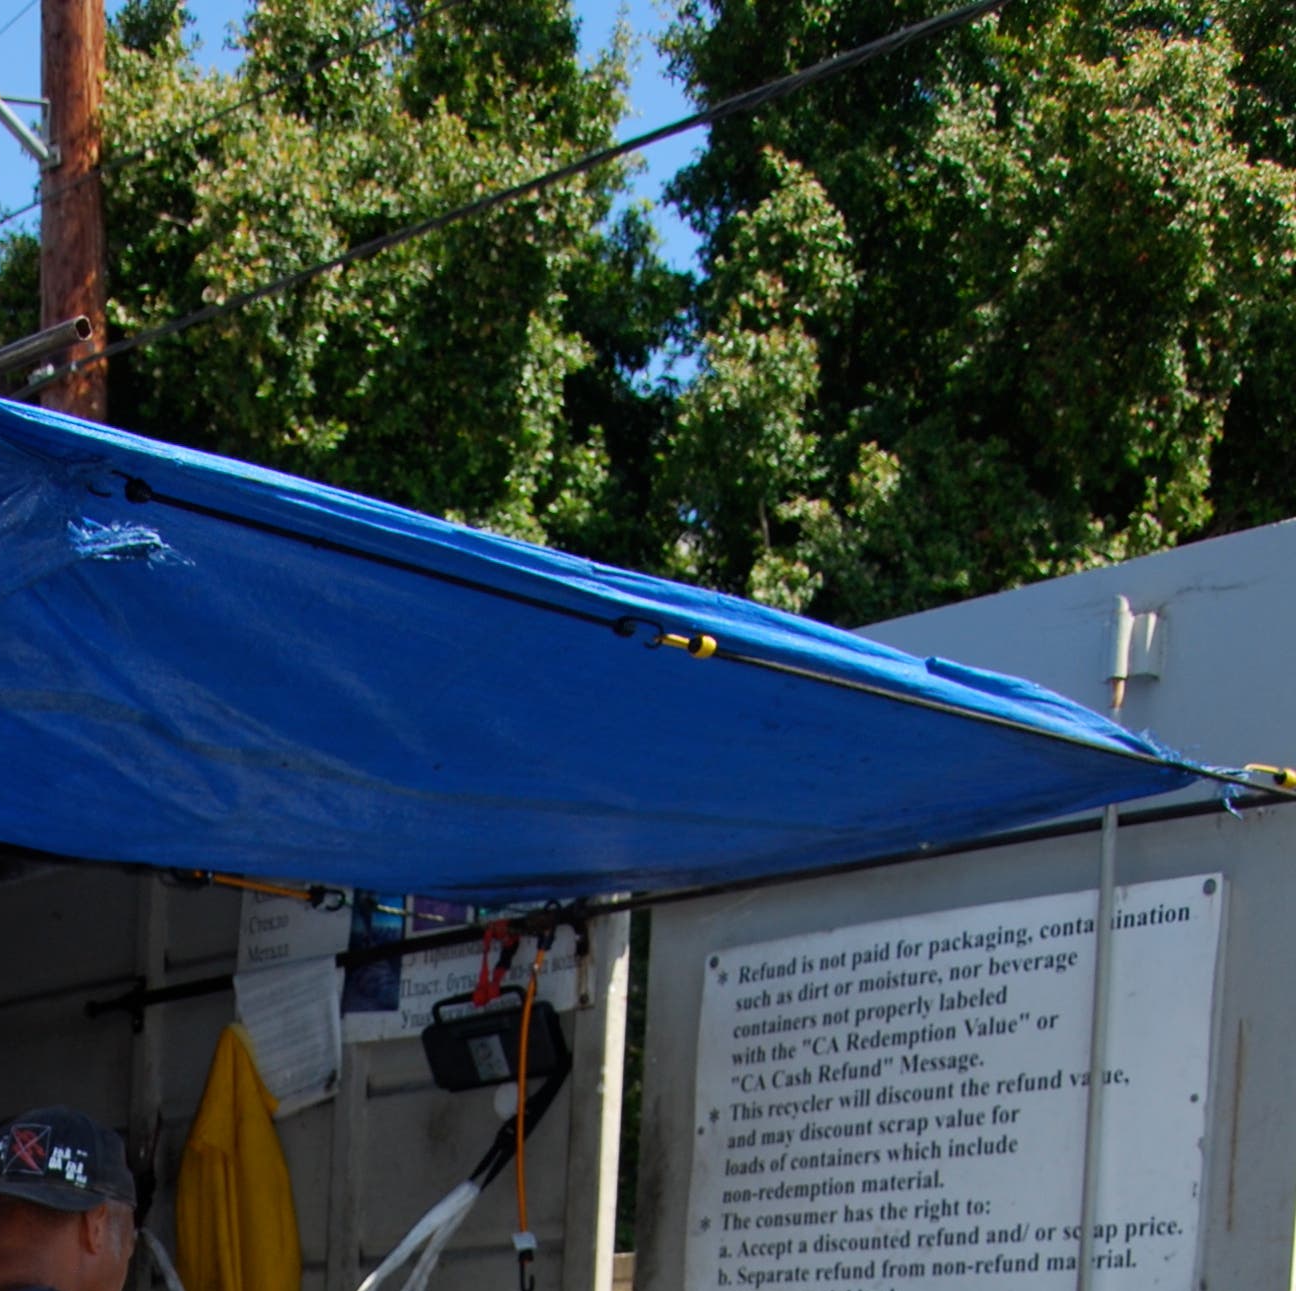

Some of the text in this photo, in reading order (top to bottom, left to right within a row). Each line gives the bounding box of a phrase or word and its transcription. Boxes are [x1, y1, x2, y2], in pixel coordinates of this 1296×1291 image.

[738, 904, 1191, 985] Refund is not paid for packaging, containation
[735, 950, 1079, 1012] such as dirt or moisture, nor beverage
[733, 985, 1008, 1040] containers not properly labeled
[732, 1012, 1059, 1066] with the "CA Redemption Value" or
[731, 1051, 984, 1093] "CA Cash Refund" Message.
[729, 1067, 1130, 1122] This recycler will discount the refund vaue,
[727, 1105, 1021, 1149] and may discount scrap value for
[724, 1134, 1019, 1177] loads of containers which include
[722, 1170, 945, 1204] non-redemption material.
[722, 1198, 992, 1231] The consumer has the right to:
[719, 1216, 1184, 1260] a. Accept a discounted refund and/ or scap price.
[718, 1248, 1138, 1289] b. Separate refund from non-refund marial.
